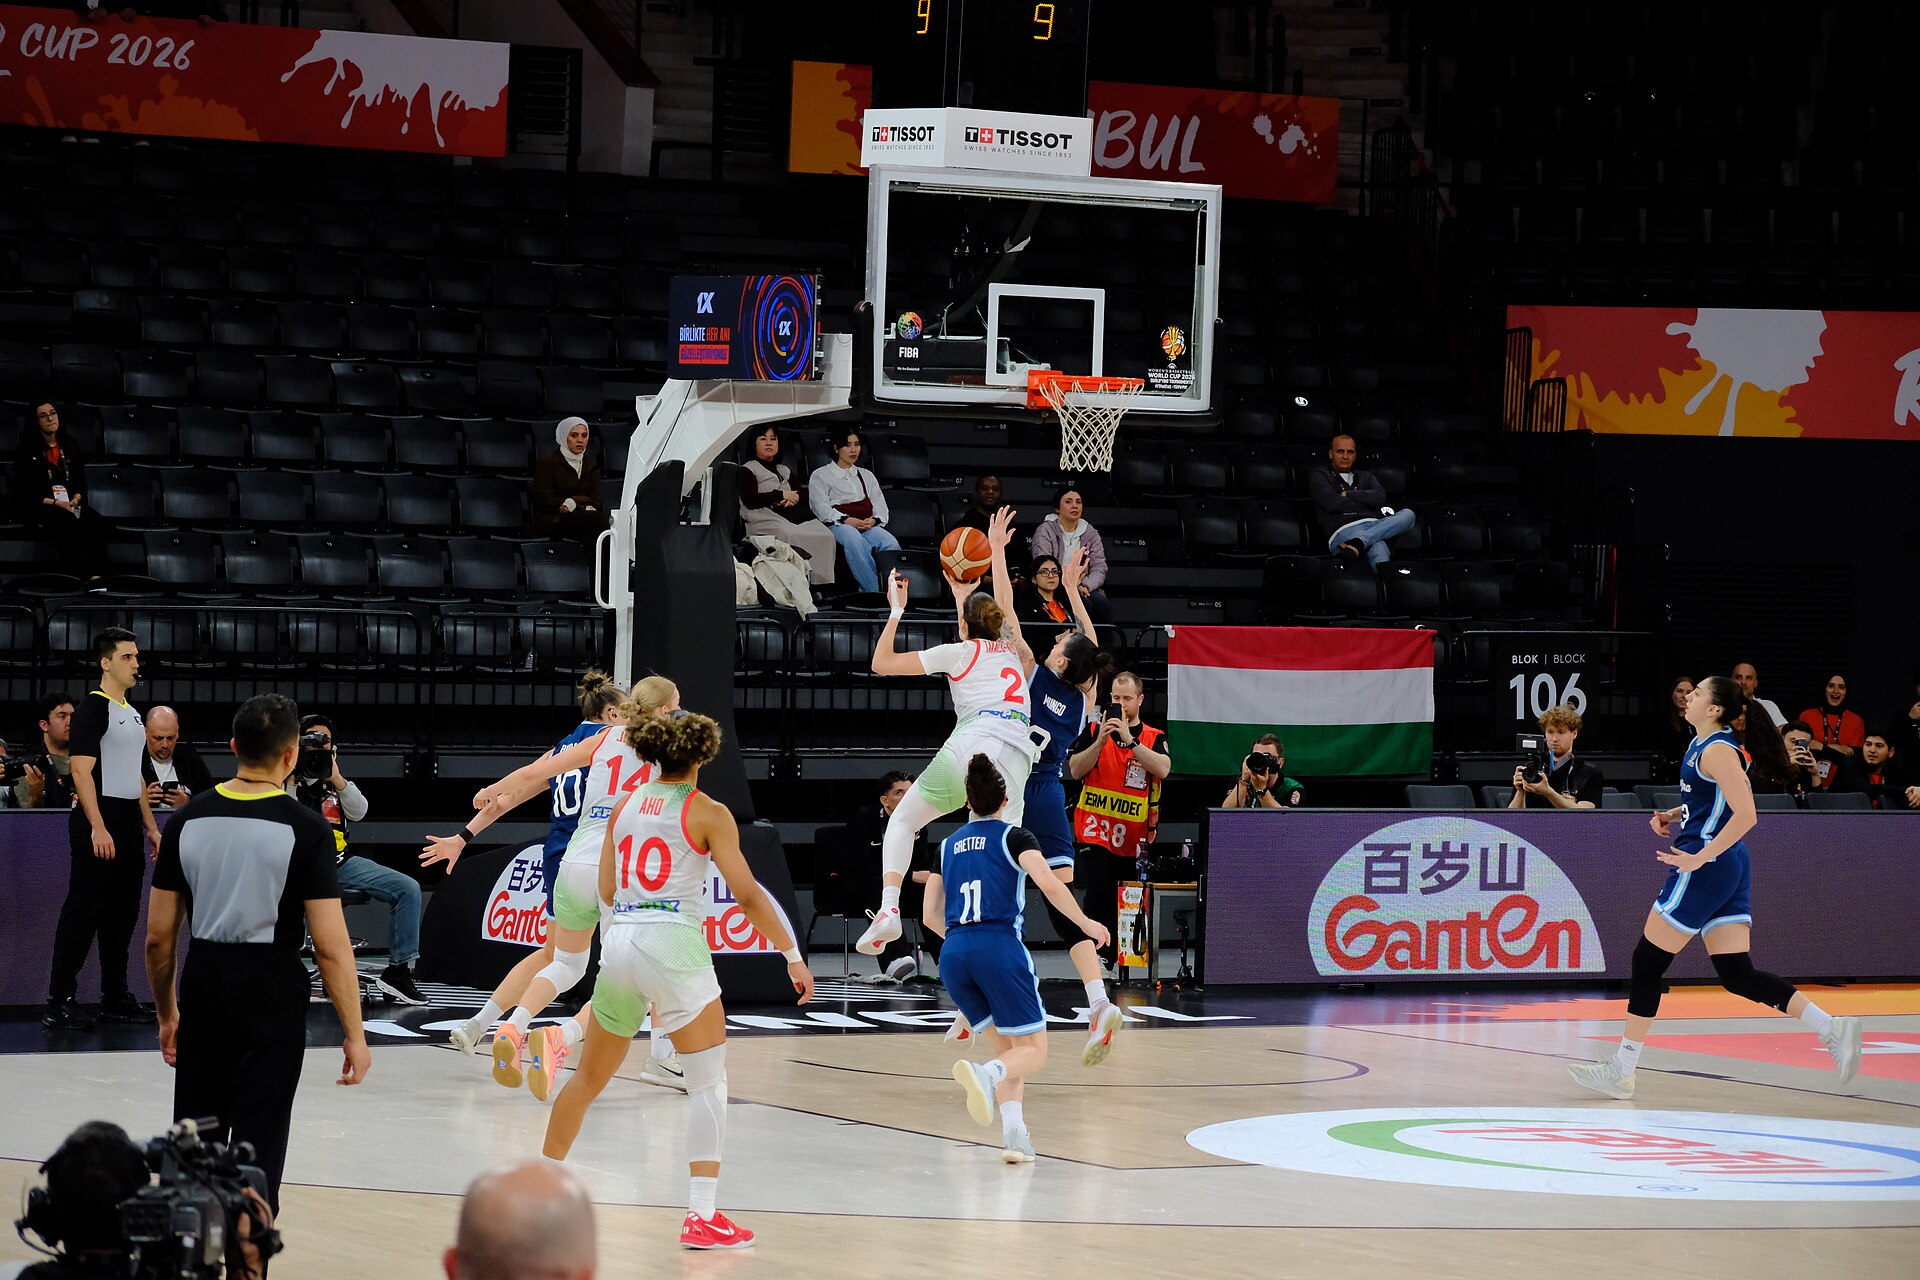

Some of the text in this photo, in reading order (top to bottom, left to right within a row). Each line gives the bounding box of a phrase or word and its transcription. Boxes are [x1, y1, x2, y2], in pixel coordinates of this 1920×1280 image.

[916, 0, 931, 34] 9
[1033, 3, 1055, 40] 9
[20, 23, 99, 62] CUP
[107, 33, 195, 70] 2026
[890, 126, 935, 142] TISSOT
[991, 147, 1026, 155] WATCHES
[996, 129, 1073, 150] TISSOT
[1088, 108, 1206, 174] BUL
[696, 292, 715, 314] 1X
[679, 324, 706, 342] BİRLİKTE
[706, 327, 718, 341] HER
[778, 321, 792, 336] 1X
[898, 346, 919, 358] FIBA
[1511, 654, 1586, 664] BLOK BLOCK
[1000, 667, 1025, 705] 2
[1509, 672, 1587, 720] 106
[1043, 693, 1067, 717] MUNGO
[606, 755, 652, 796] 14
[552, 768, 583, 818] 10
[639, 796, 665, 816] AHO
[953, 836, 987, 855] GRETTER
[1083, 815, 1127, 848] 238
[508, 859, 547, 894] 百岁
[617, 834, 673, 892] 10
[1363, 841, 1527, 895] 百岁山
[487, 890, 547, 945] Gante
[960, 879, 982, 925] 11
[1324, 894, 1582, 971] Ganten
